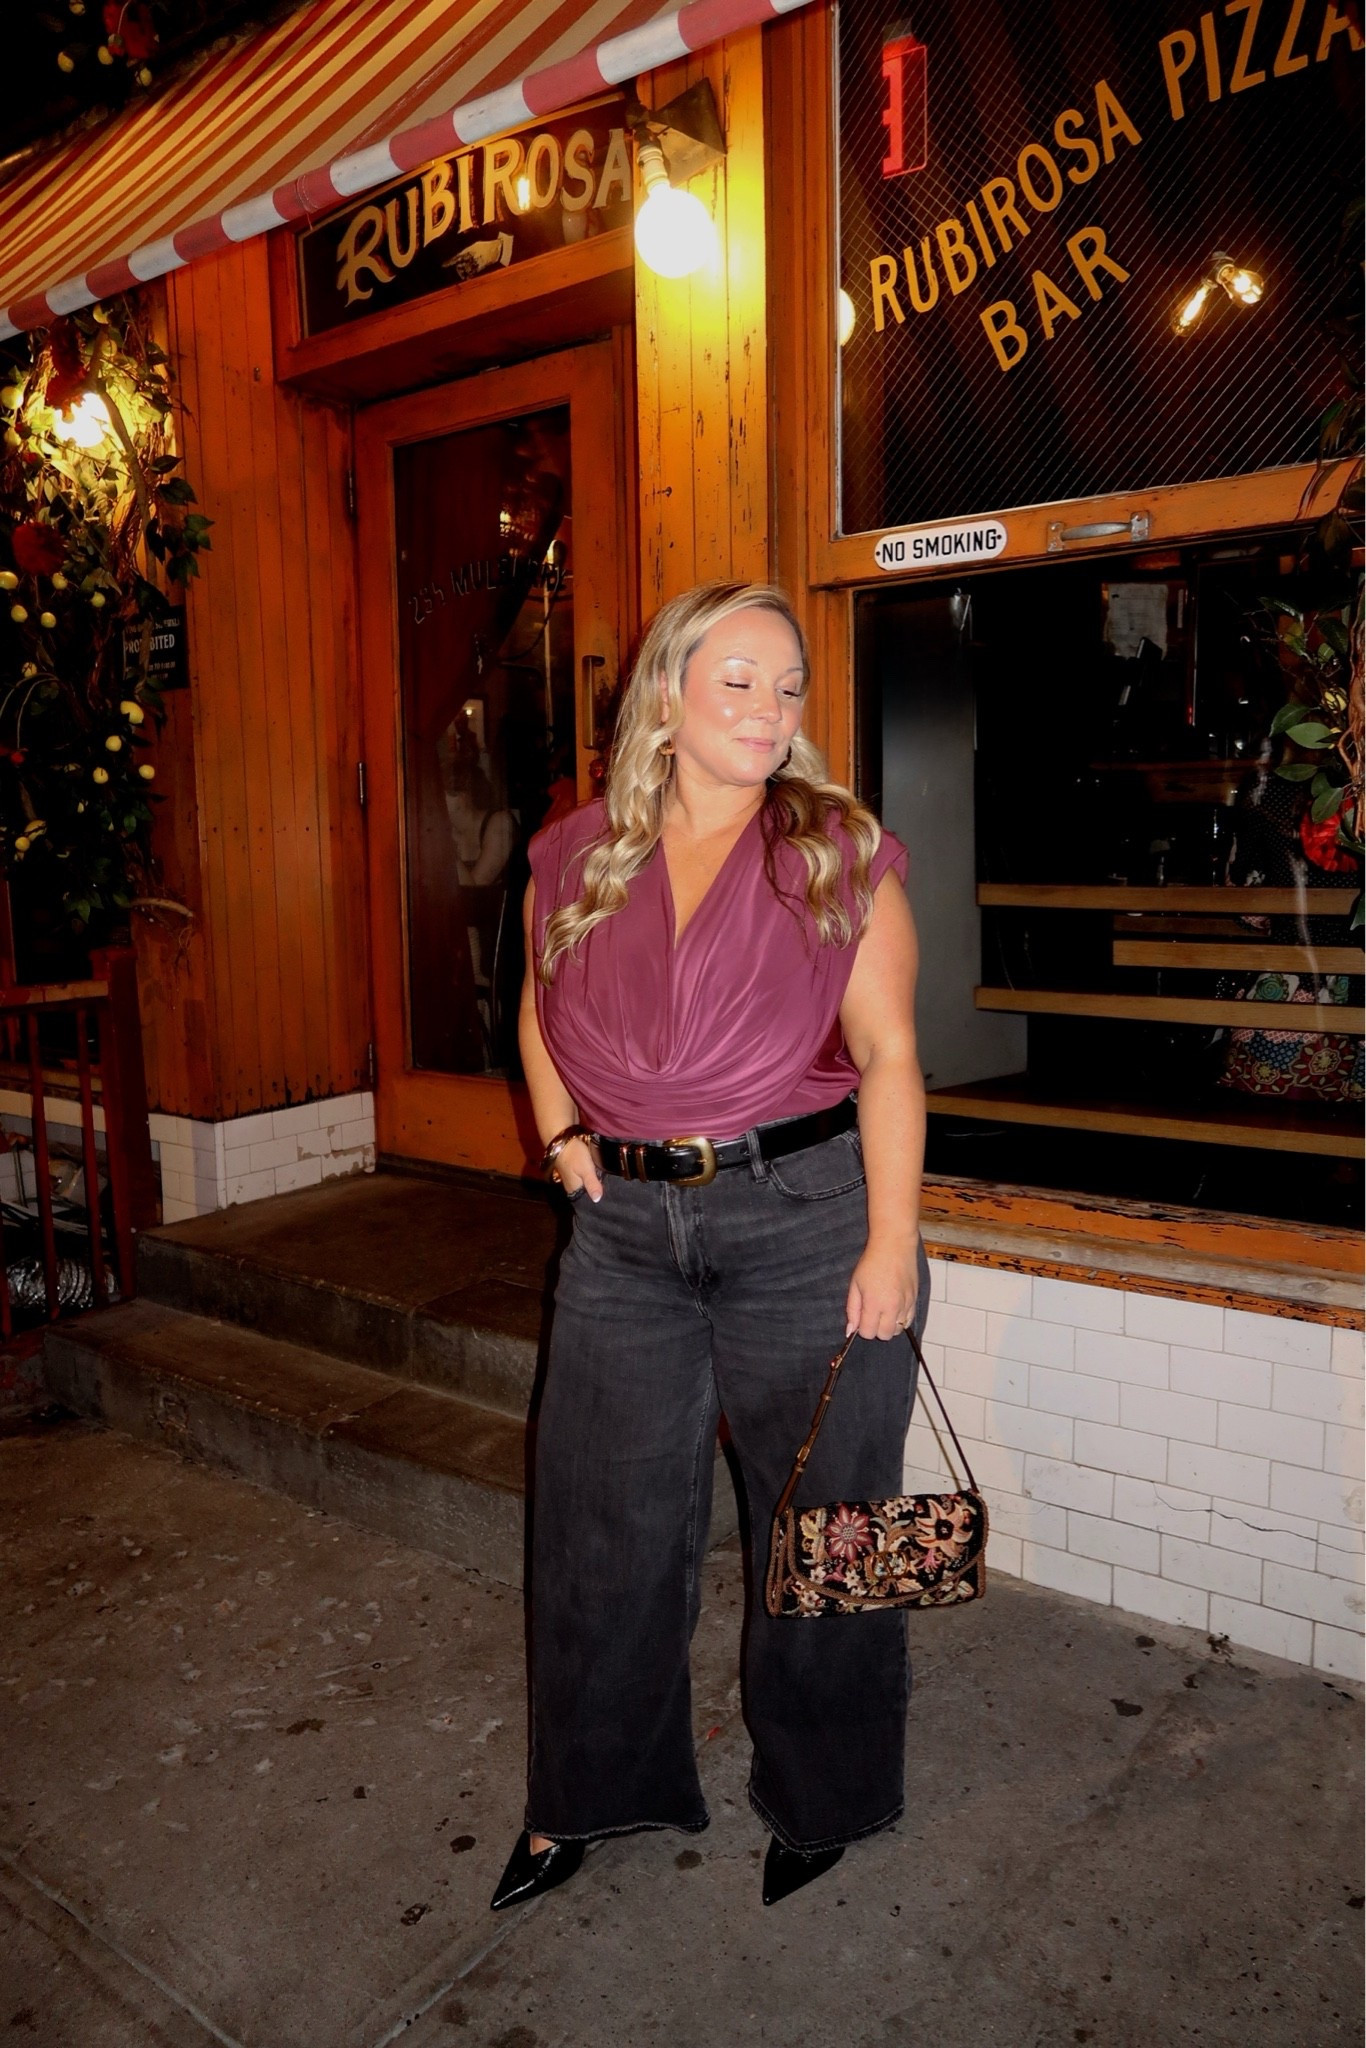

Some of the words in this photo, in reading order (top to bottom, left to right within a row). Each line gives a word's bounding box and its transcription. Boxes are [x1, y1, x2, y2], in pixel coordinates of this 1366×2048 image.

[337, 128, 632, 308] RUBIROSA
[870, 79, 1143, 332] RUBIROSA
[1158, 0, 1365, 121] PIZZA
[980, 226, 1131, 372] BAR
[882, 541, 905, 563] NO
[913, 528, 997, 559] SMOKING
[124, 634, 176, 654] PROBITED
